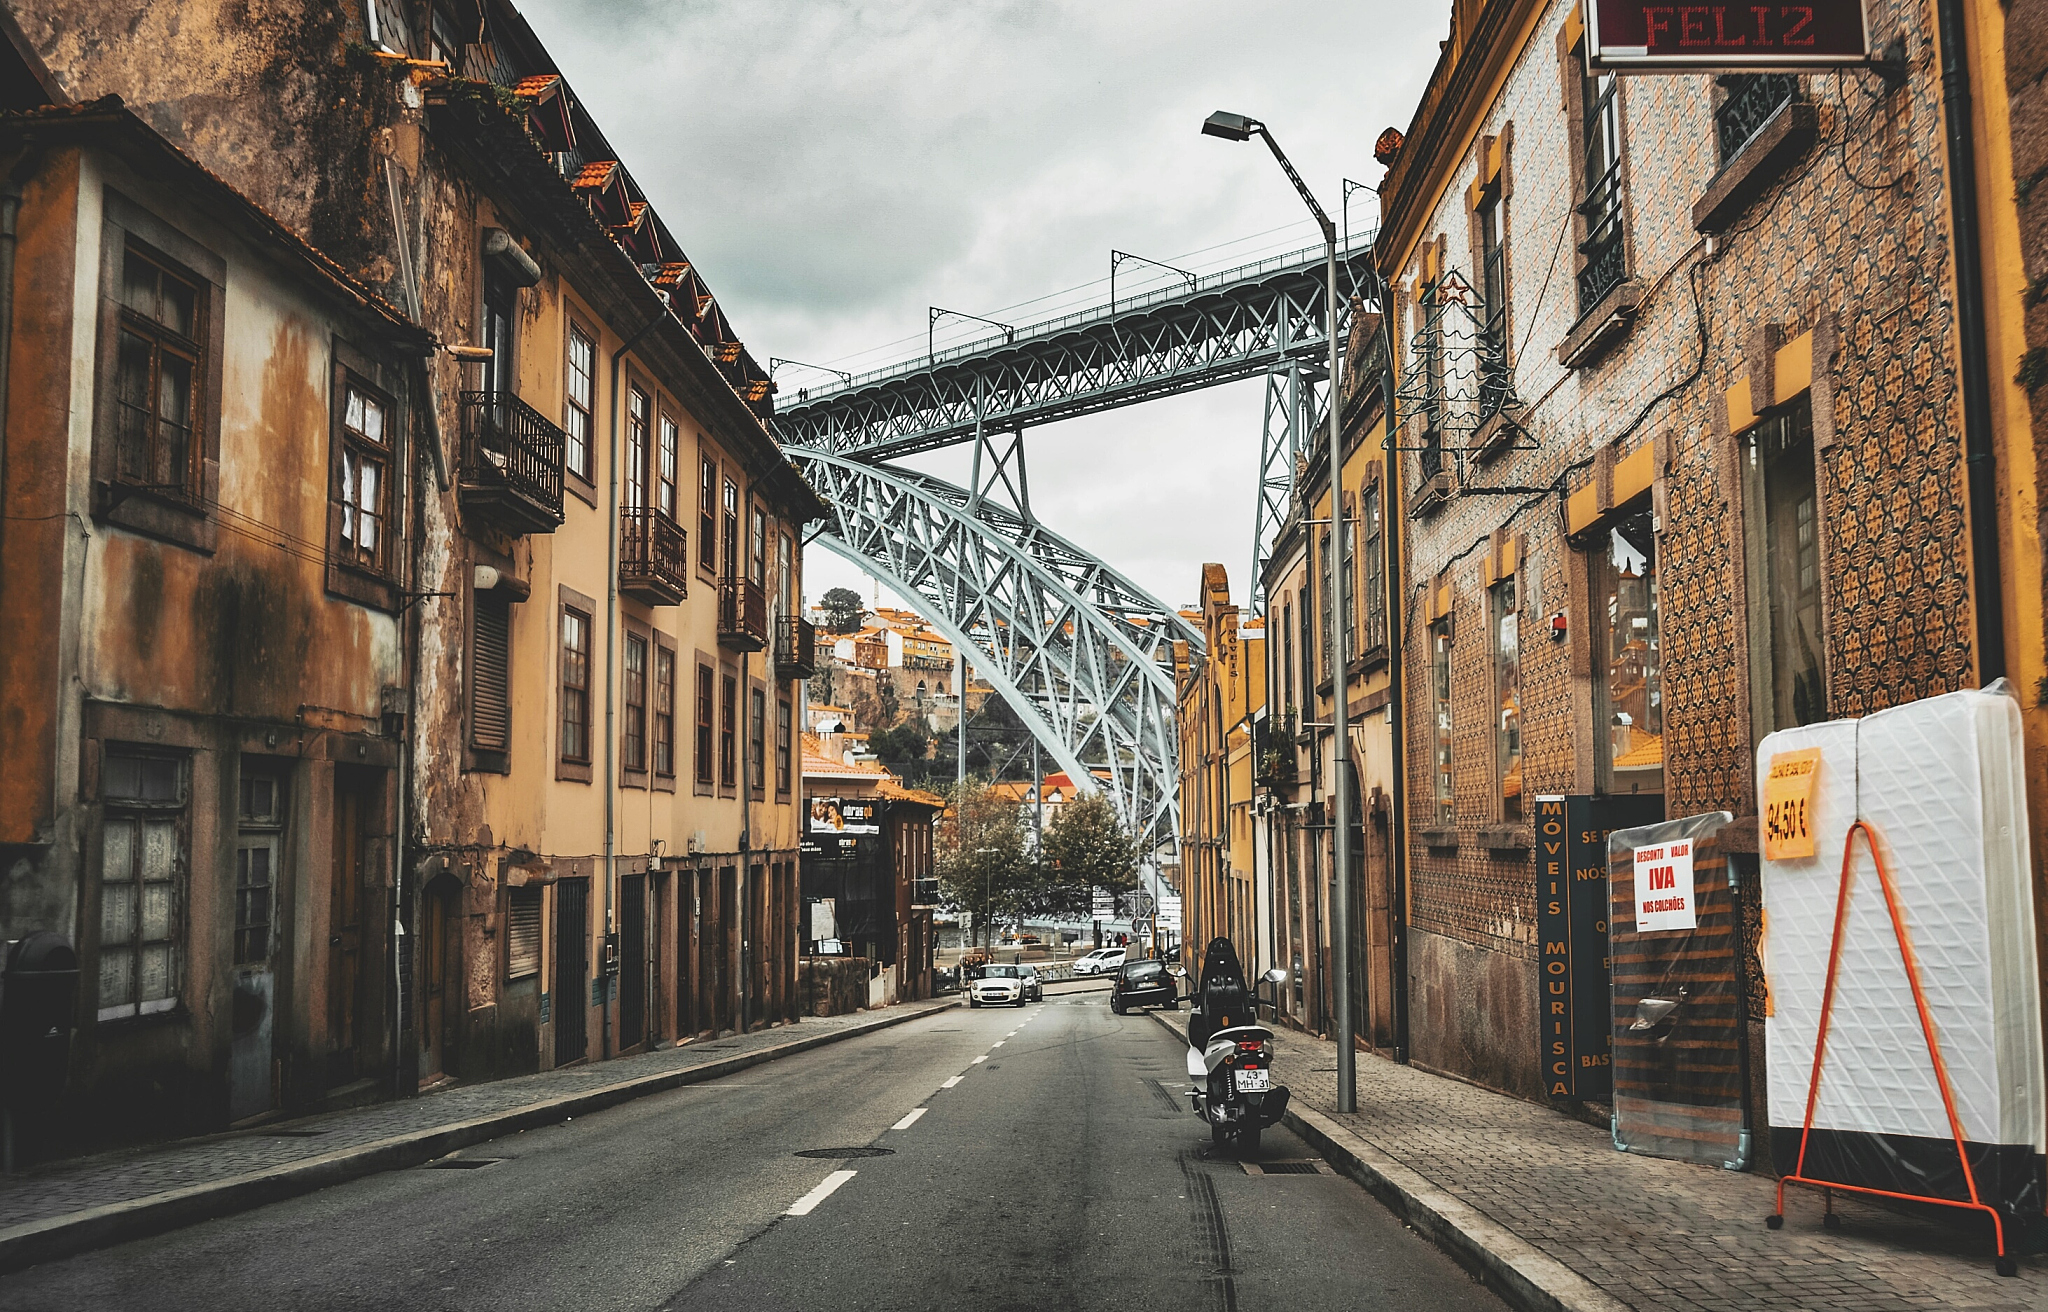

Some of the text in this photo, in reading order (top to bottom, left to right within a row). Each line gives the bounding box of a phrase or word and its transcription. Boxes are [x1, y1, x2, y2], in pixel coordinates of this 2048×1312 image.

[1642, 6, 1815, 46] FELIZ
[1228, 628, 1238, 677] MÓVEIS
[1767, 799, 1796, 848] 94,50
[1582, 830, 1598, 843] SE
[1636, 843, 1689, 863] DESCONTO VALOR
[1649, 865, 1675, 890] IVA
[1642, 895, 1685, 913] NOS COLCHÕES
[1541, 802, 1569, 1095] MÓVEIS MOURISCA
[1581, 1053, 1613, 1068] BAS
[1246, 1070, 1258, 1079] 43
